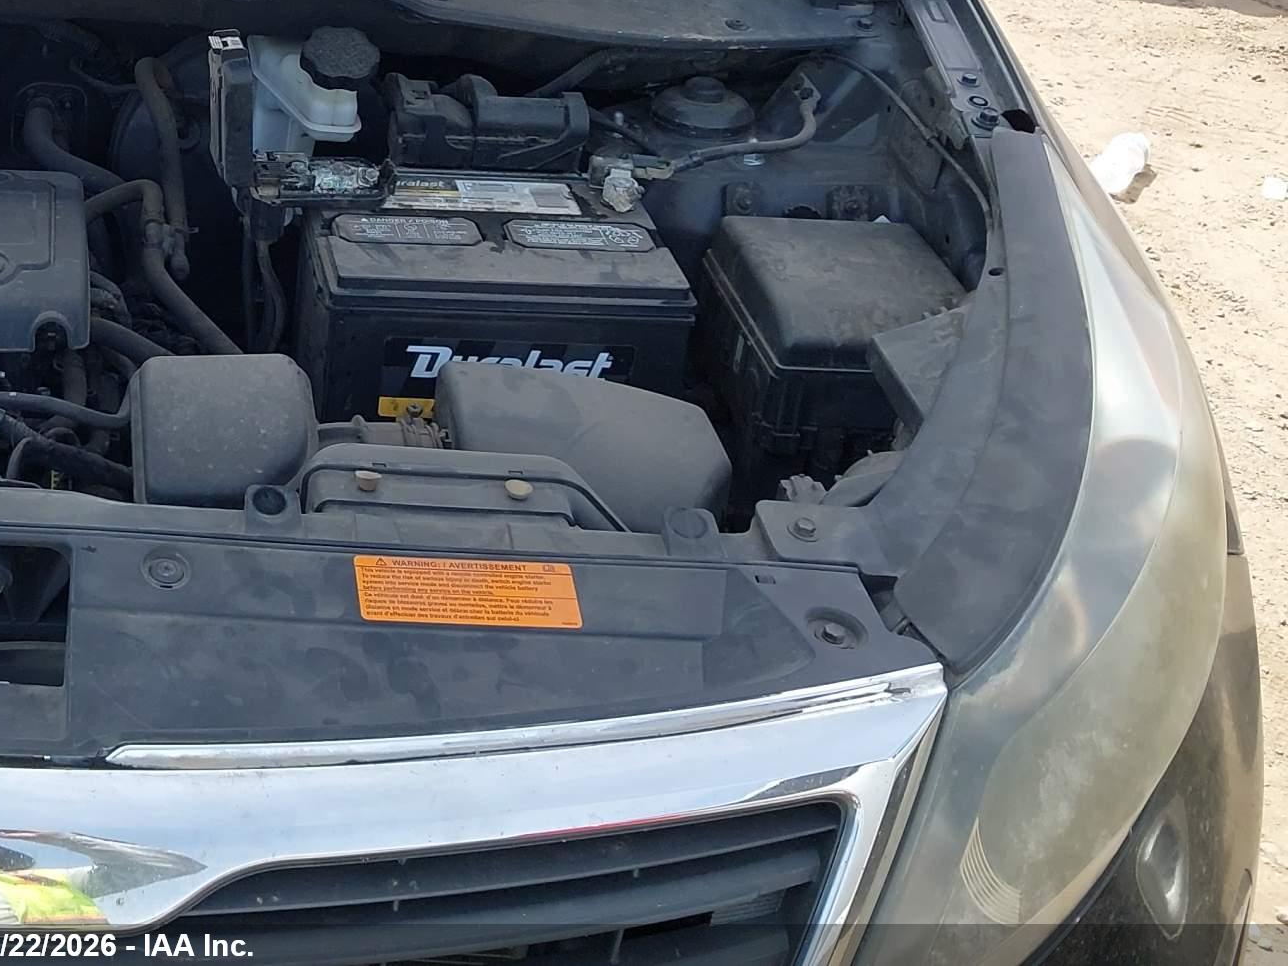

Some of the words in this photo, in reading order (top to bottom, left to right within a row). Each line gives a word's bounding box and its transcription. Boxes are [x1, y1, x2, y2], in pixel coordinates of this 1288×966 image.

[396, 180, 444, 188] ralast
[406, 345, 613, 380] Dlst
[448, 562, 527, 570] AVERTISSEMENT
